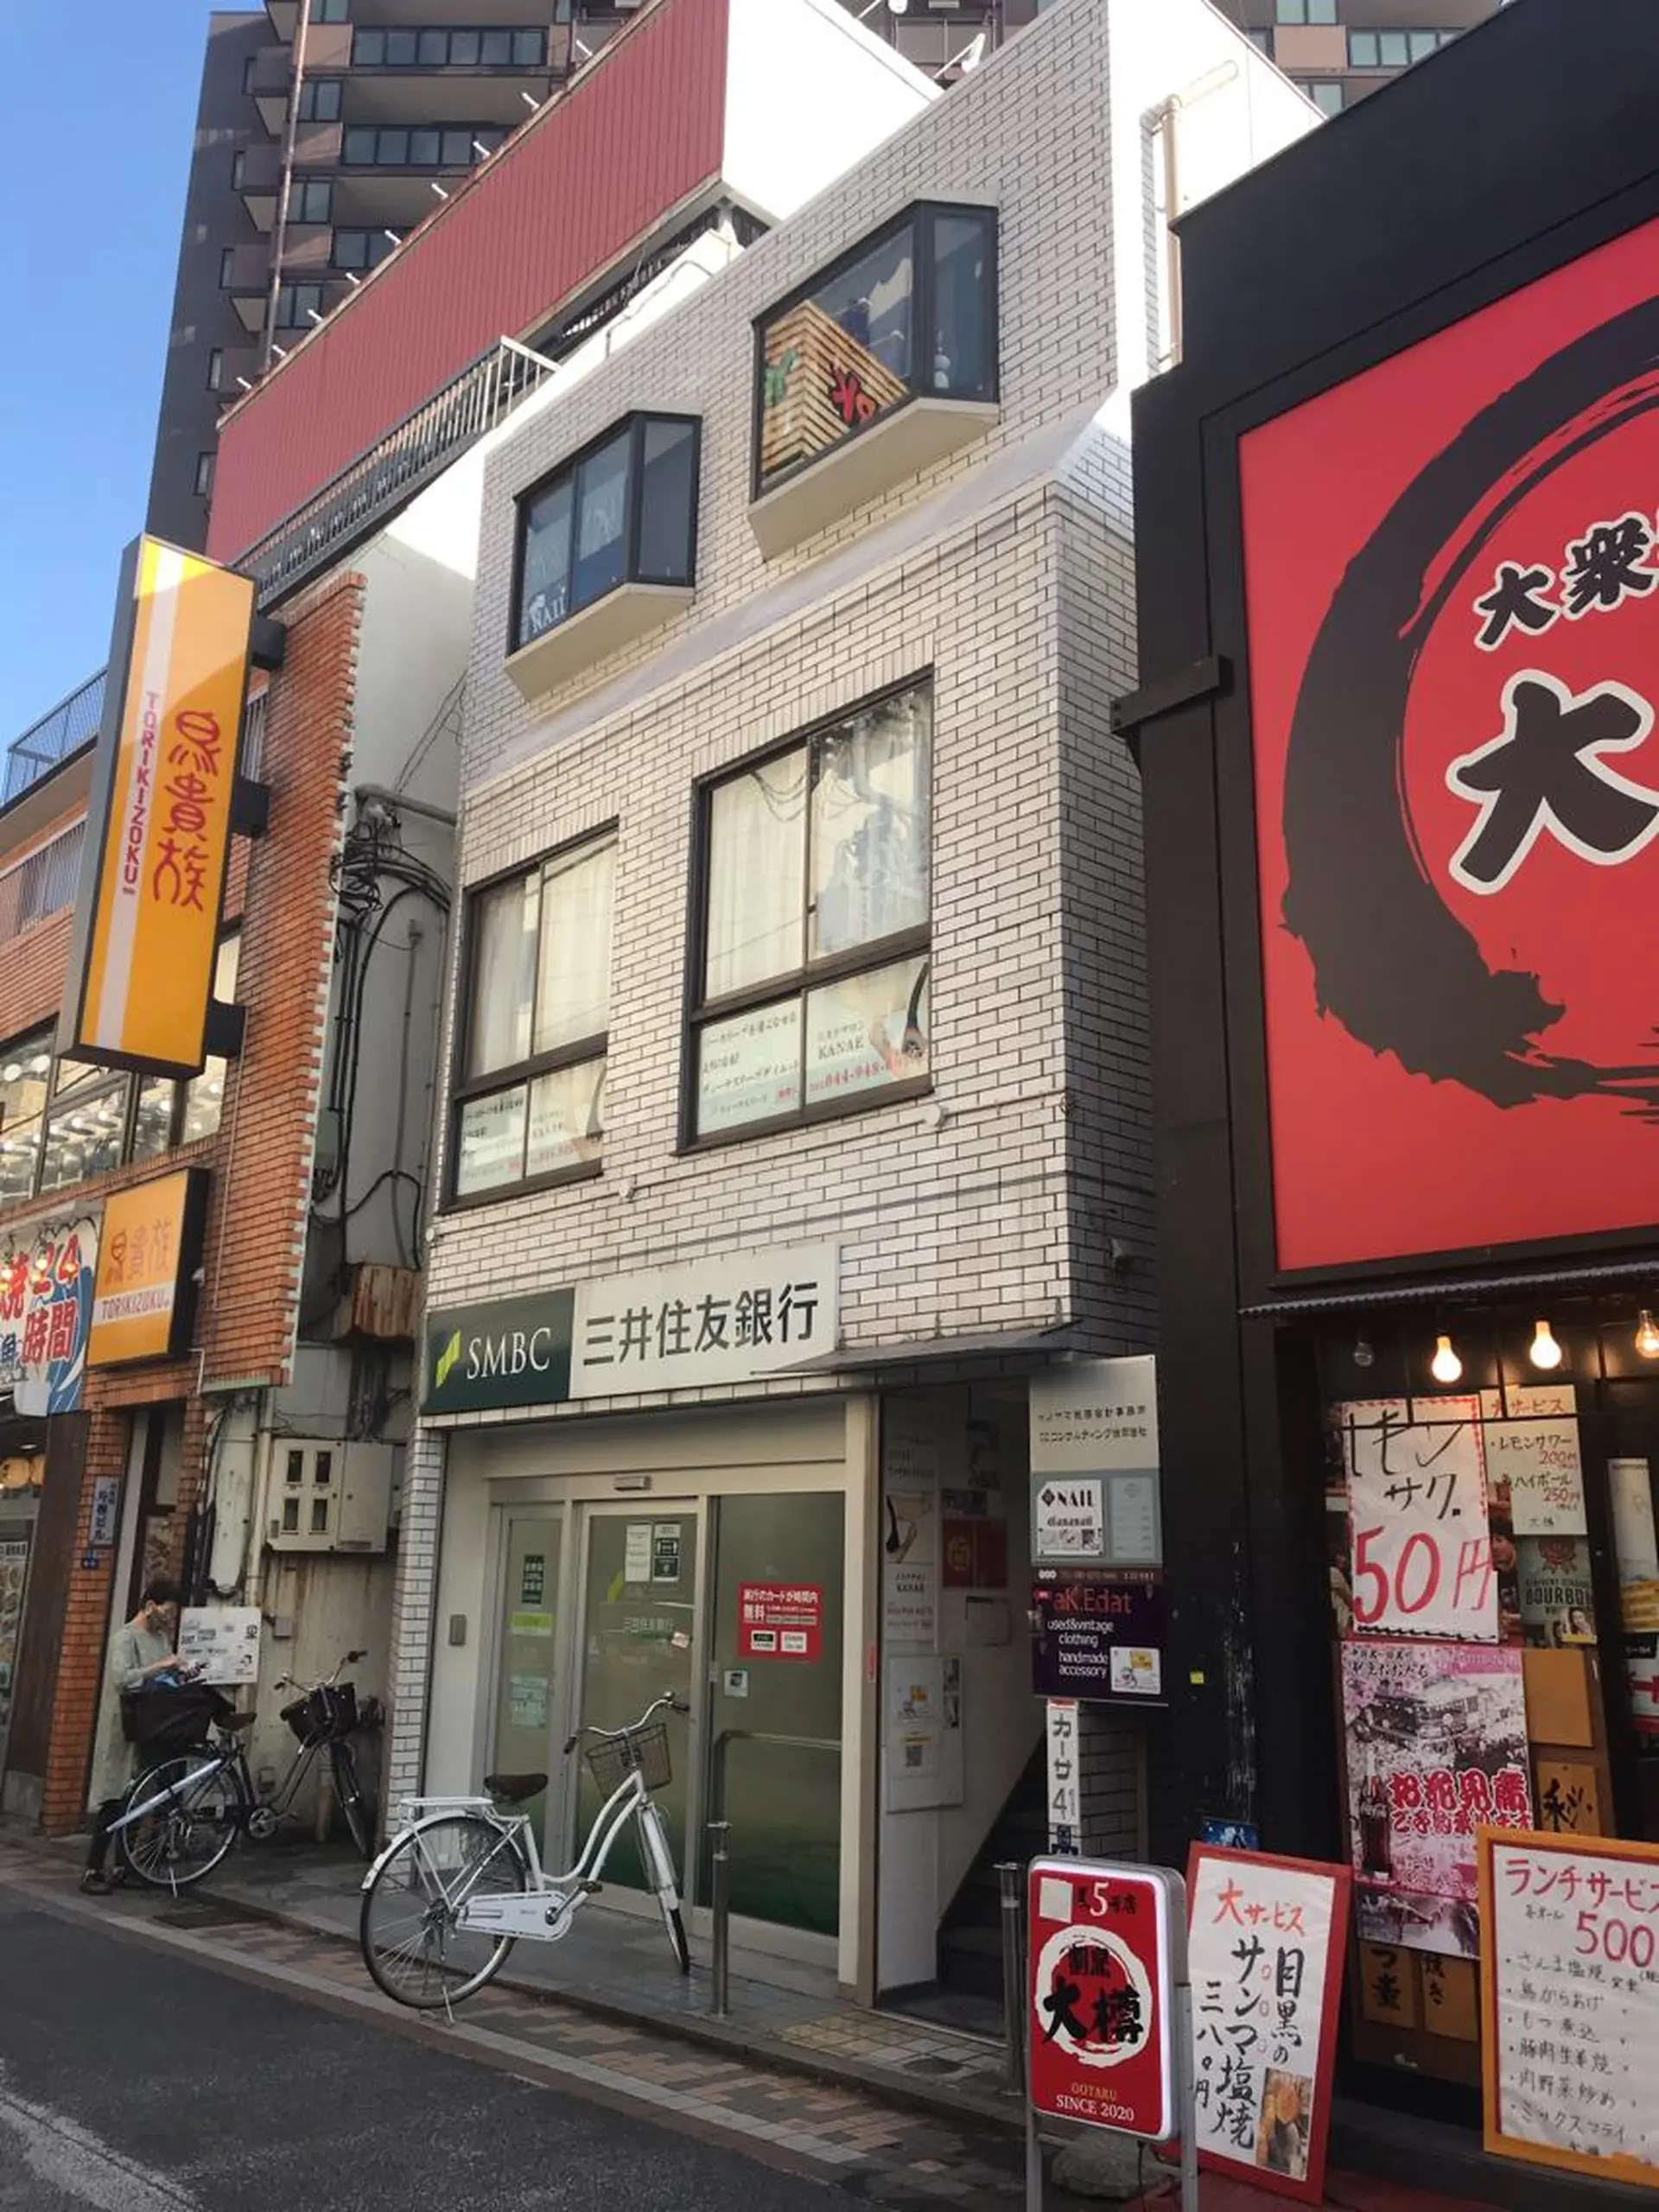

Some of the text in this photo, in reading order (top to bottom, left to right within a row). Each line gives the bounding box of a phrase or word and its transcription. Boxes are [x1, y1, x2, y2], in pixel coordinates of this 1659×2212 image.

[1475, 514, 1657, 649] 大衆
[124, 691, 157, 885] TORIKIZOKU
[153, 709, 219, 912] 鳥貴族
[1448, 672, 1659, 891] 大
[32, 1233, 80, 1296] 24
[22, 1300, 79, 1364] 時間
[101, 1291, 165, 1320] TORIKIZOKU
[582, 1281, 819, 1367] 三井住友銀行
[467, 1327, 552, 1380] SMBC
[1498, 1434, 1573, 1450] レモンサワー
[1514, 1472, 1573, 1489] ハイボール
[1352, 1526, 1493, 1625] 50円
[1046, 1617, 1115, 1635] used&vintage
[1058, 1633, 1099, 1649] clothing
[1058, 1650, 1109, 1665] handmade
[1058, 1664, 1108, 1679] accessory
[1211, 1878, 1306, 1937] 大サービス
[1575, 1910, 1655, 1968] 500
[1041, 1977, 1145, 2045] 大樽
[1270, 1946, 1306, 2065] 目黒の
[1210, 1937, 1265, 2151] サンマ塩焼
[1056, 2094, 1135, 2122] SINCE 2020
[1071, 2081, 1118, 2101] OOTARU
[1518, 2069, 1617, 2110] 肉野菜炒め
[1520, 2098, 1628, 2144] ミックスフライ
